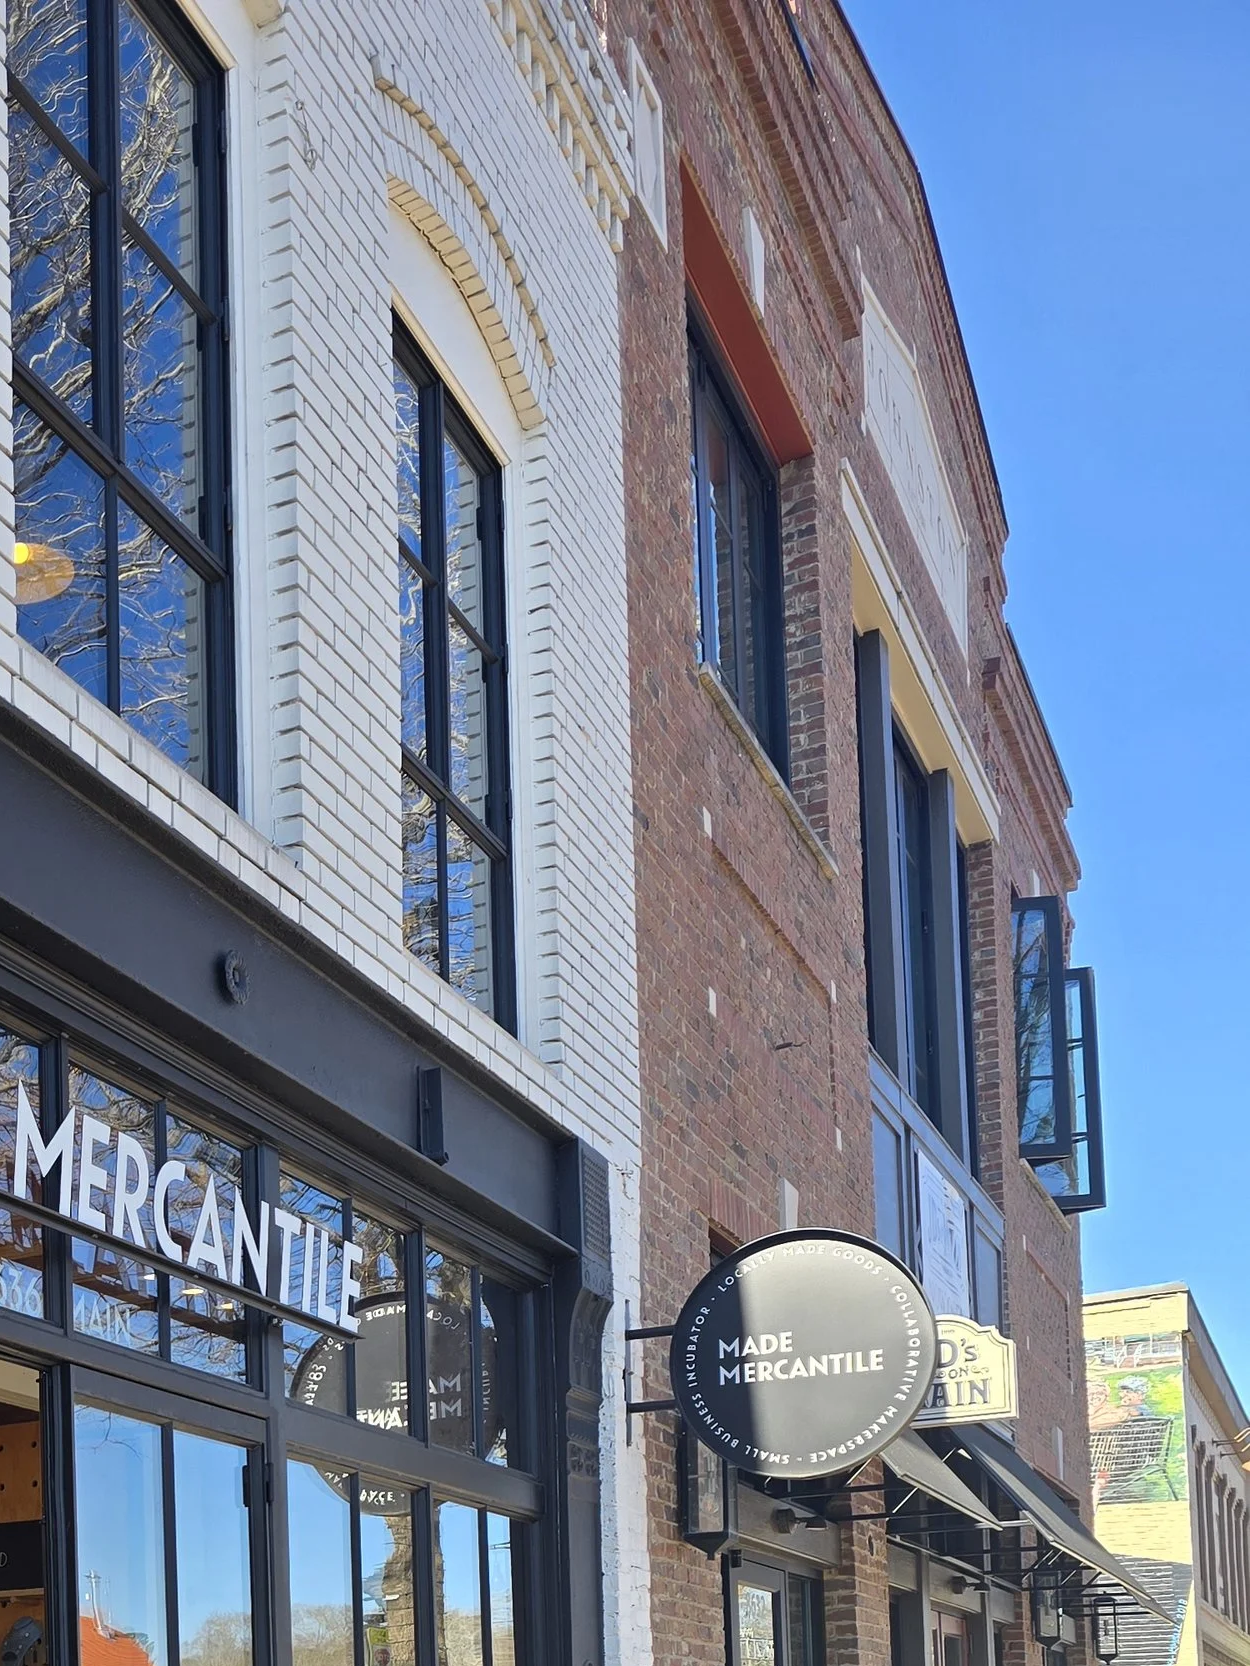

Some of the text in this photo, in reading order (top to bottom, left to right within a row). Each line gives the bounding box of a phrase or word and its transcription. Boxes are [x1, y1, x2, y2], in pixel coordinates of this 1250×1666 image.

[13, 1078, 364, 1334] MERCANTILE
[718, 1244, 883, 1292] LOCALLY MADE GOODS
[718, 1331, 793, 1359] MADE
[718, 1348, 884, 1386] MERCANTILE
[686, 1305, 791, 1465] SMALL BUSINESS INCUBATOR
[809, 1284, 921, 1463] COLLABORATIVE MAKERSPACE
[948, 1365, 970, 1379] ON
